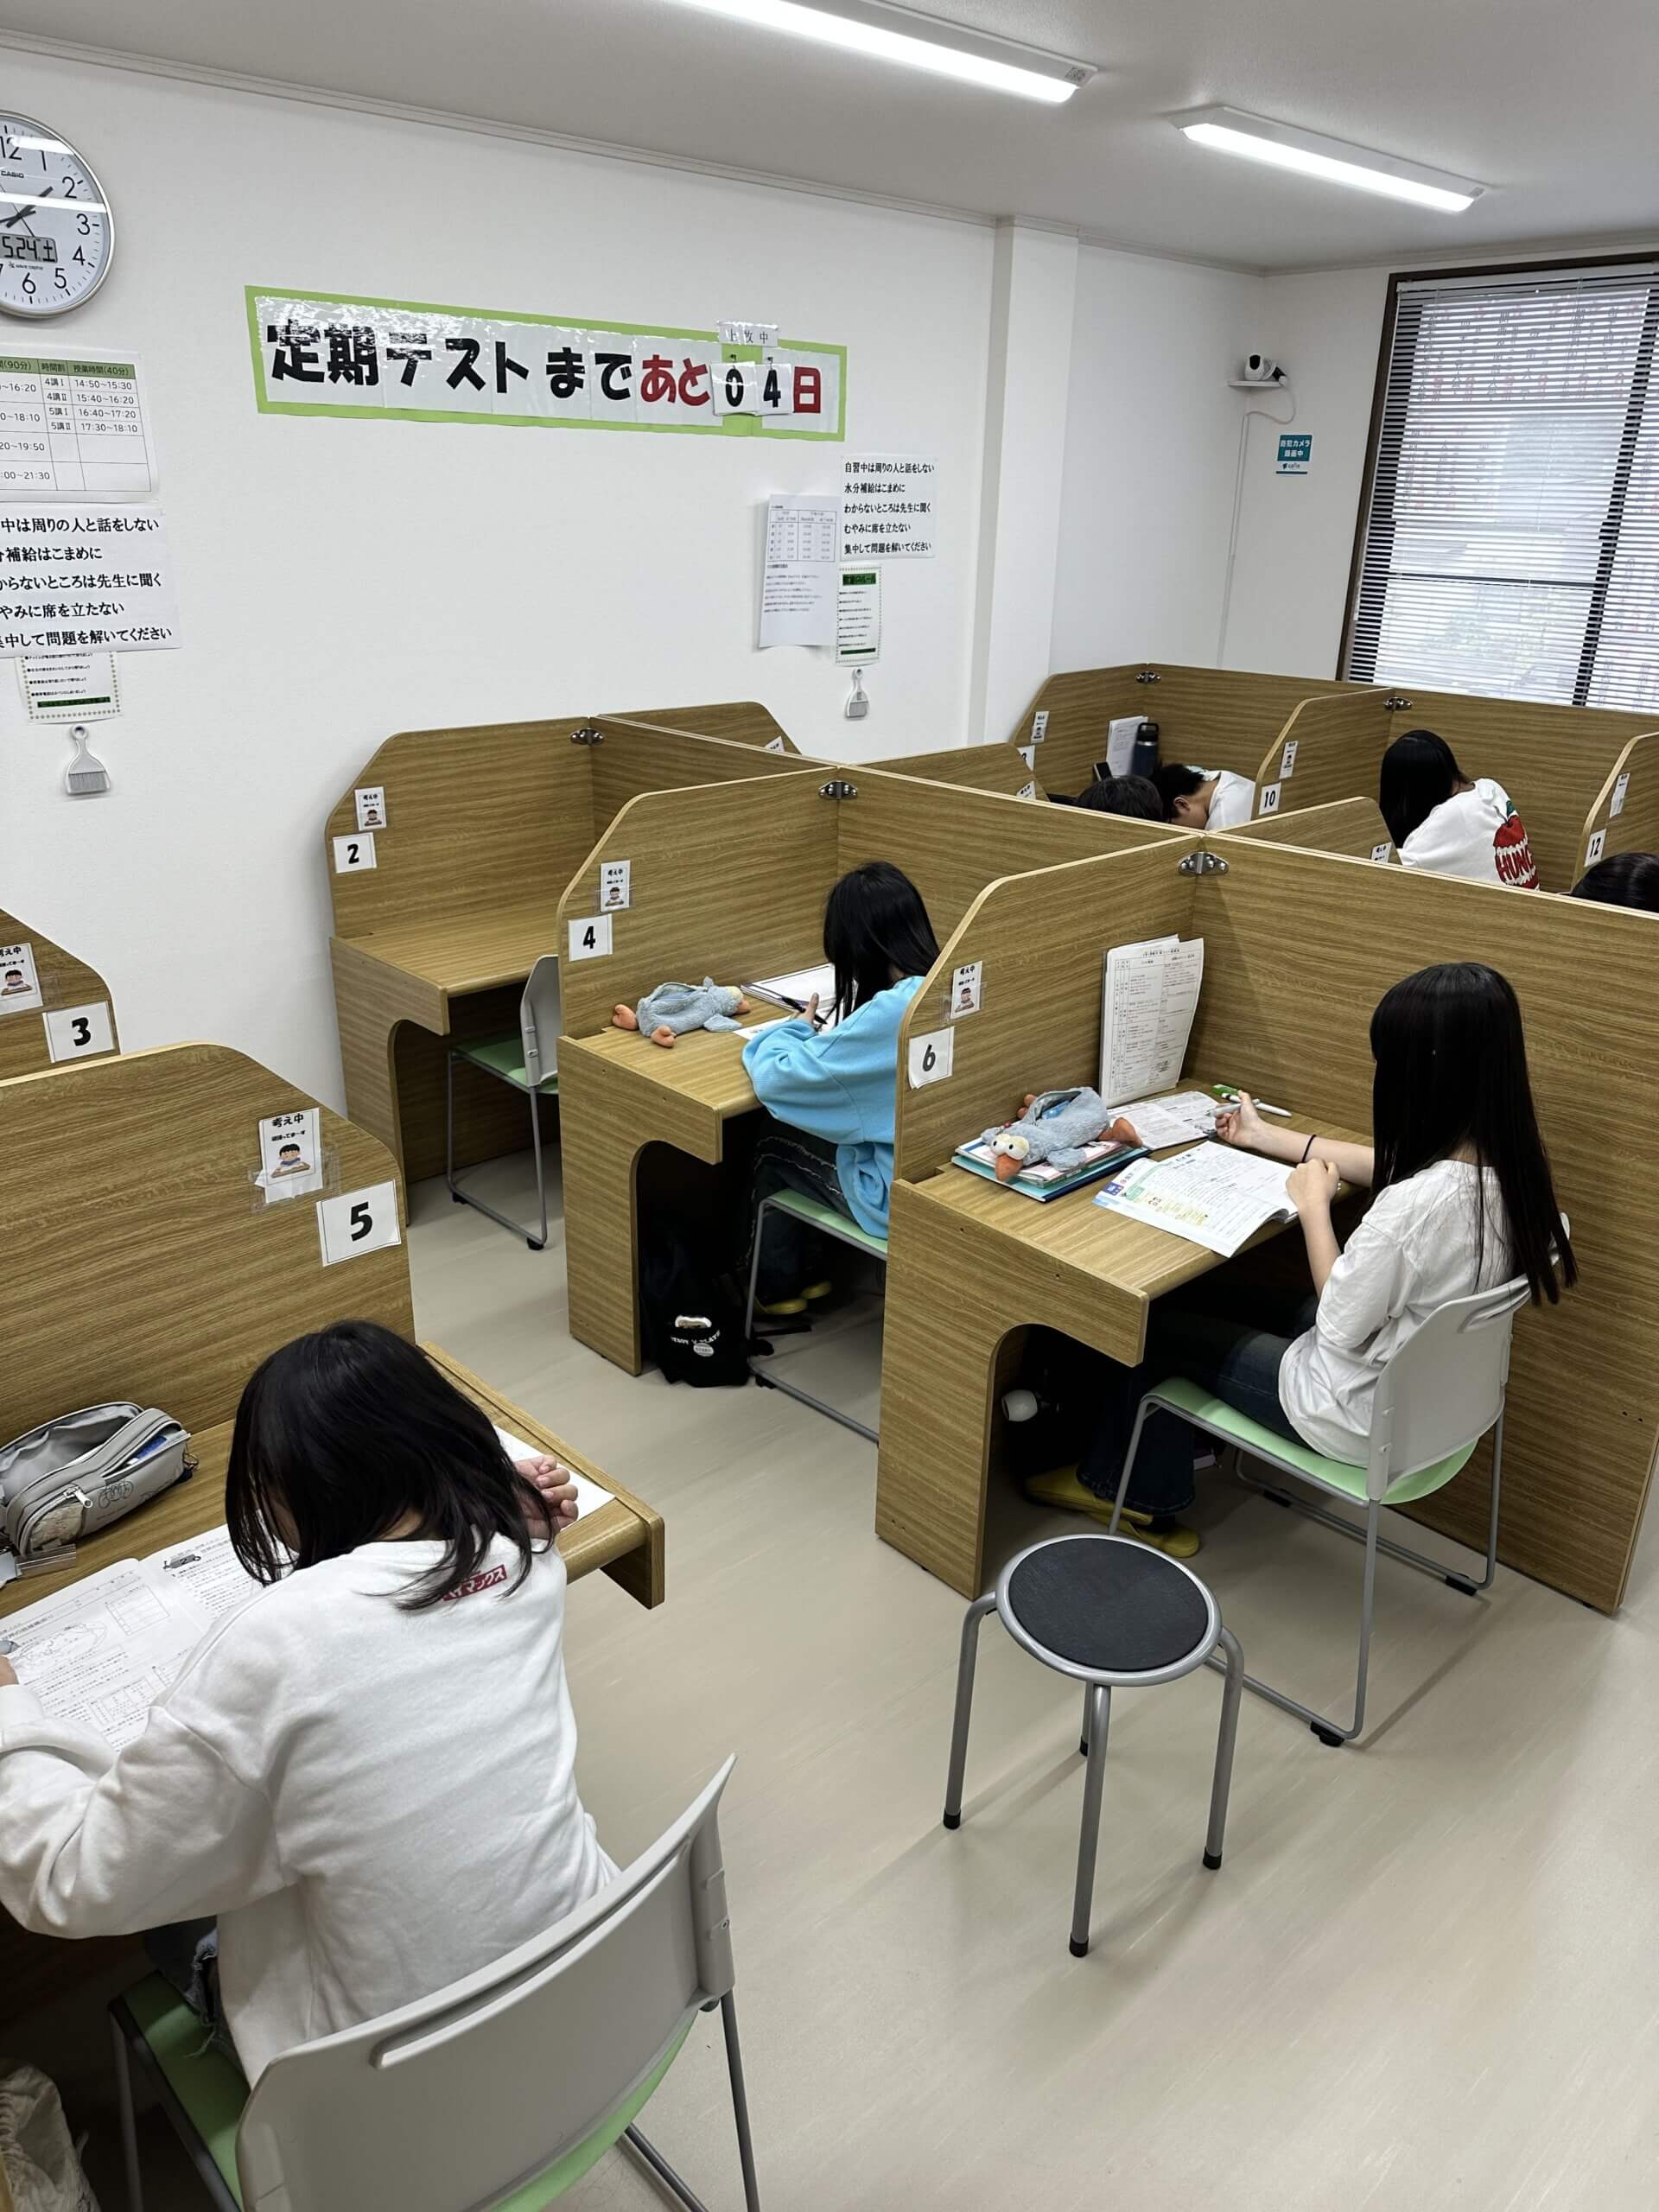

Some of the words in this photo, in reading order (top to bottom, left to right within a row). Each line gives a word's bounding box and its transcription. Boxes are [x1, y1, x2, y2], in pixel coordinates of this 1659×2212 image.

[61, 176, 77, 198] 2
[76, 213, 90, 235] 3
[73, 245, 86, 265] 4
[22, 272, 35, 294] 6
[54, 268, 67, 289] 5
[845, 461, 934, 474] 自習中は周りの人と話をしない
[845, 483, 906, 493] 水分補給はこまめに
[844, 502, 931, 513] わからないところは先生に聞く
[2, 518, 159, 533] 中は周りの人と話をしない
[844, 523, 911, 534] むやみに席を立たない
[844, 542, 931, 555] 集中して問題を解いてください
[1264, 791, 1275, 808] 10
[347, 844, 359, 864] 2
[1590, 837, 1601, 857] 12
[582, 925, 595, 949] 4
[72, 1017, 91, 1046] 3
[922, 1044, 936, 1071] 6
[272, 1113, 304, 1127] 考え中
[351, 1201, 372, 1242] 5
